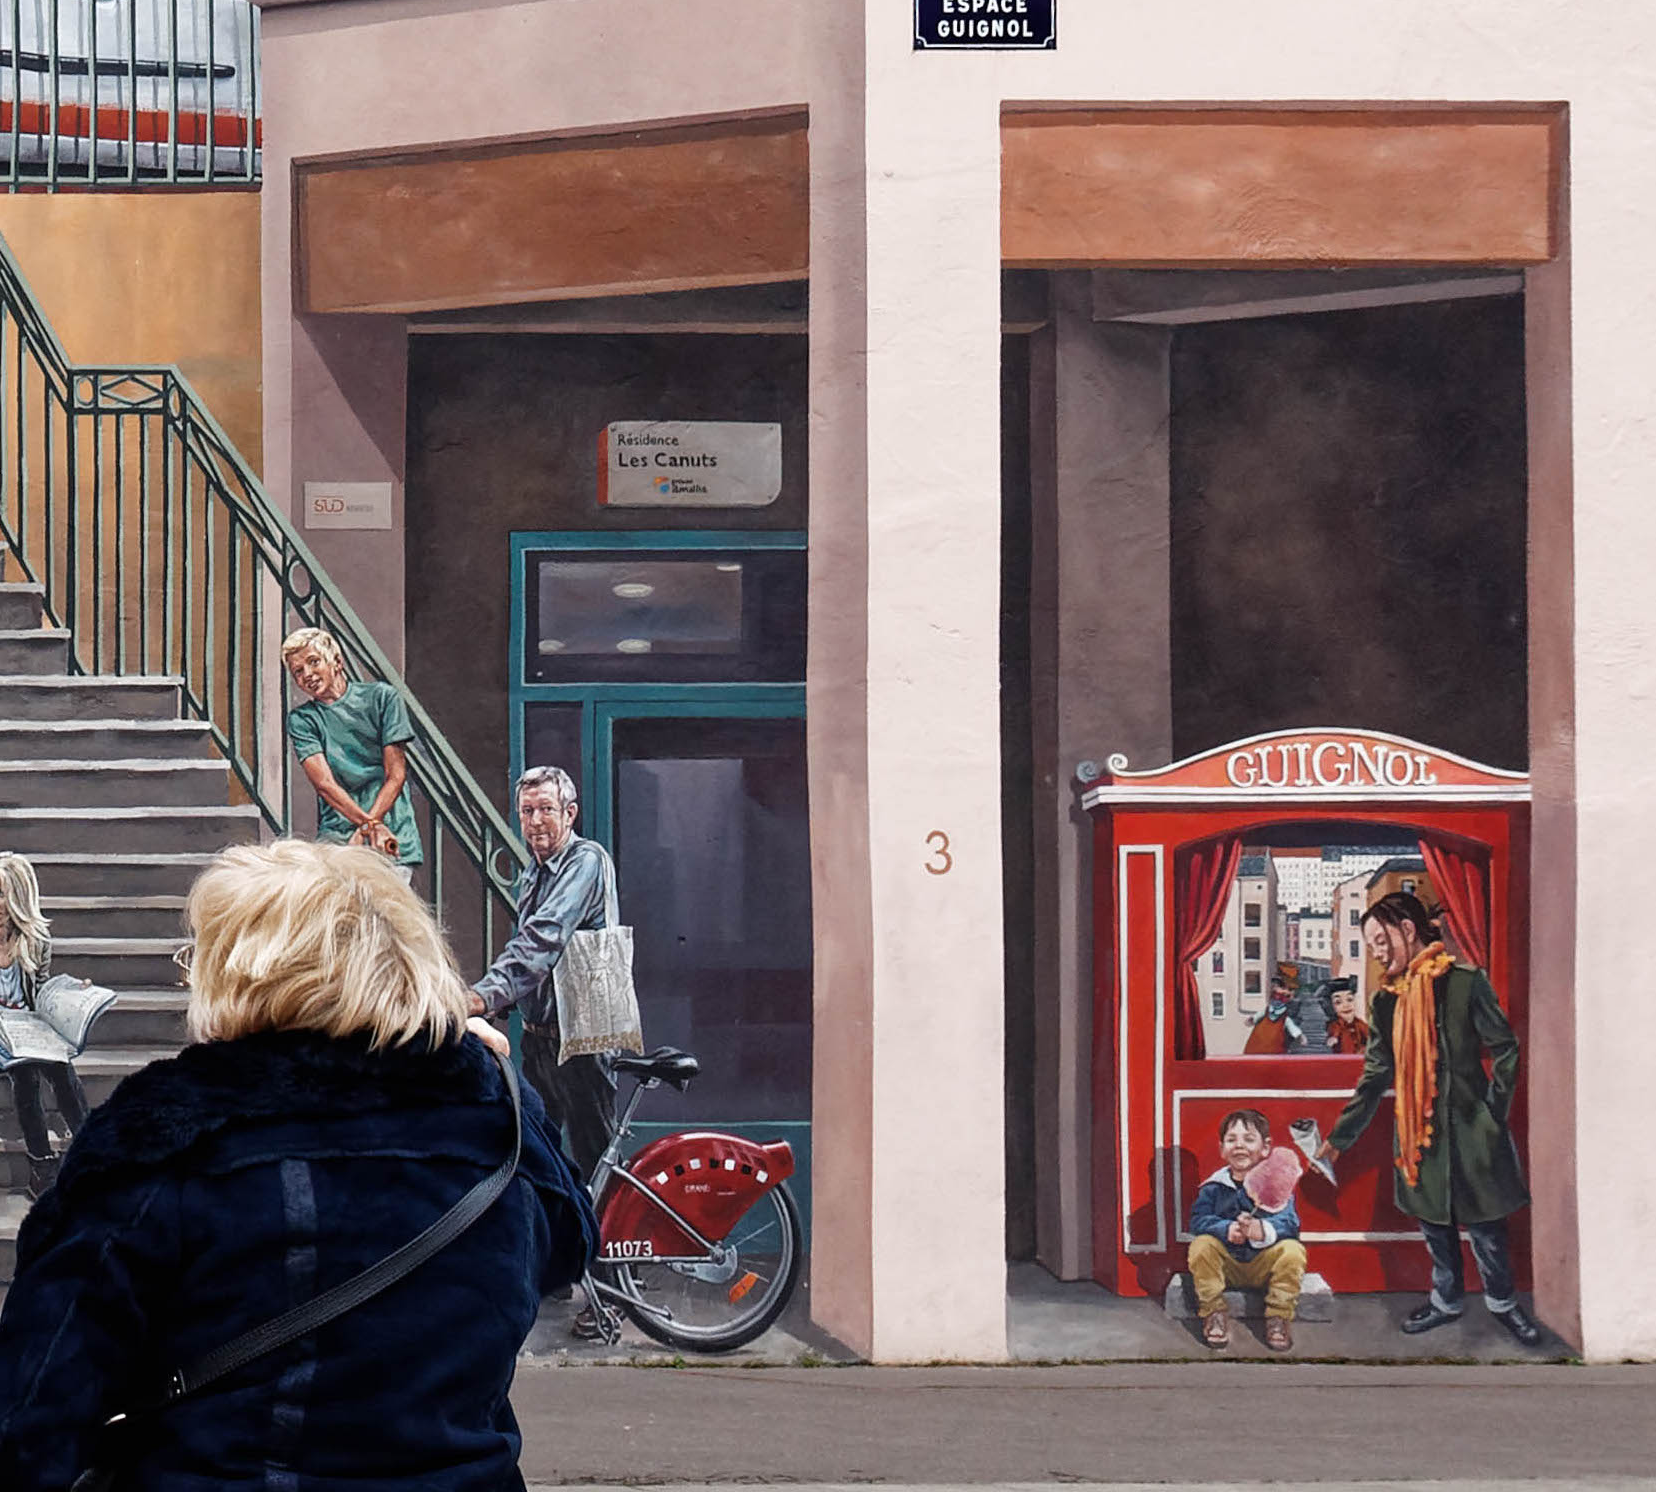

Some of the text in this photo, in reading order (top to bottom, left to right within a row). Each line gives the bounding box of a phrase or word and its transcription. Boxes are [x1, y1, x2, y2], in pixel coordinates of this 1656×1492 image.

[938, 19, 1033, 37] GUIGNOL
[617, 433, 679, 446] Résidence
[618, 452, 717, 468] Les Canuts
[1226, 740, 1436, 788] GUIGNOL
[924, 830, 952, 875] 3
[605, 1240, 653, 1258] 11073
